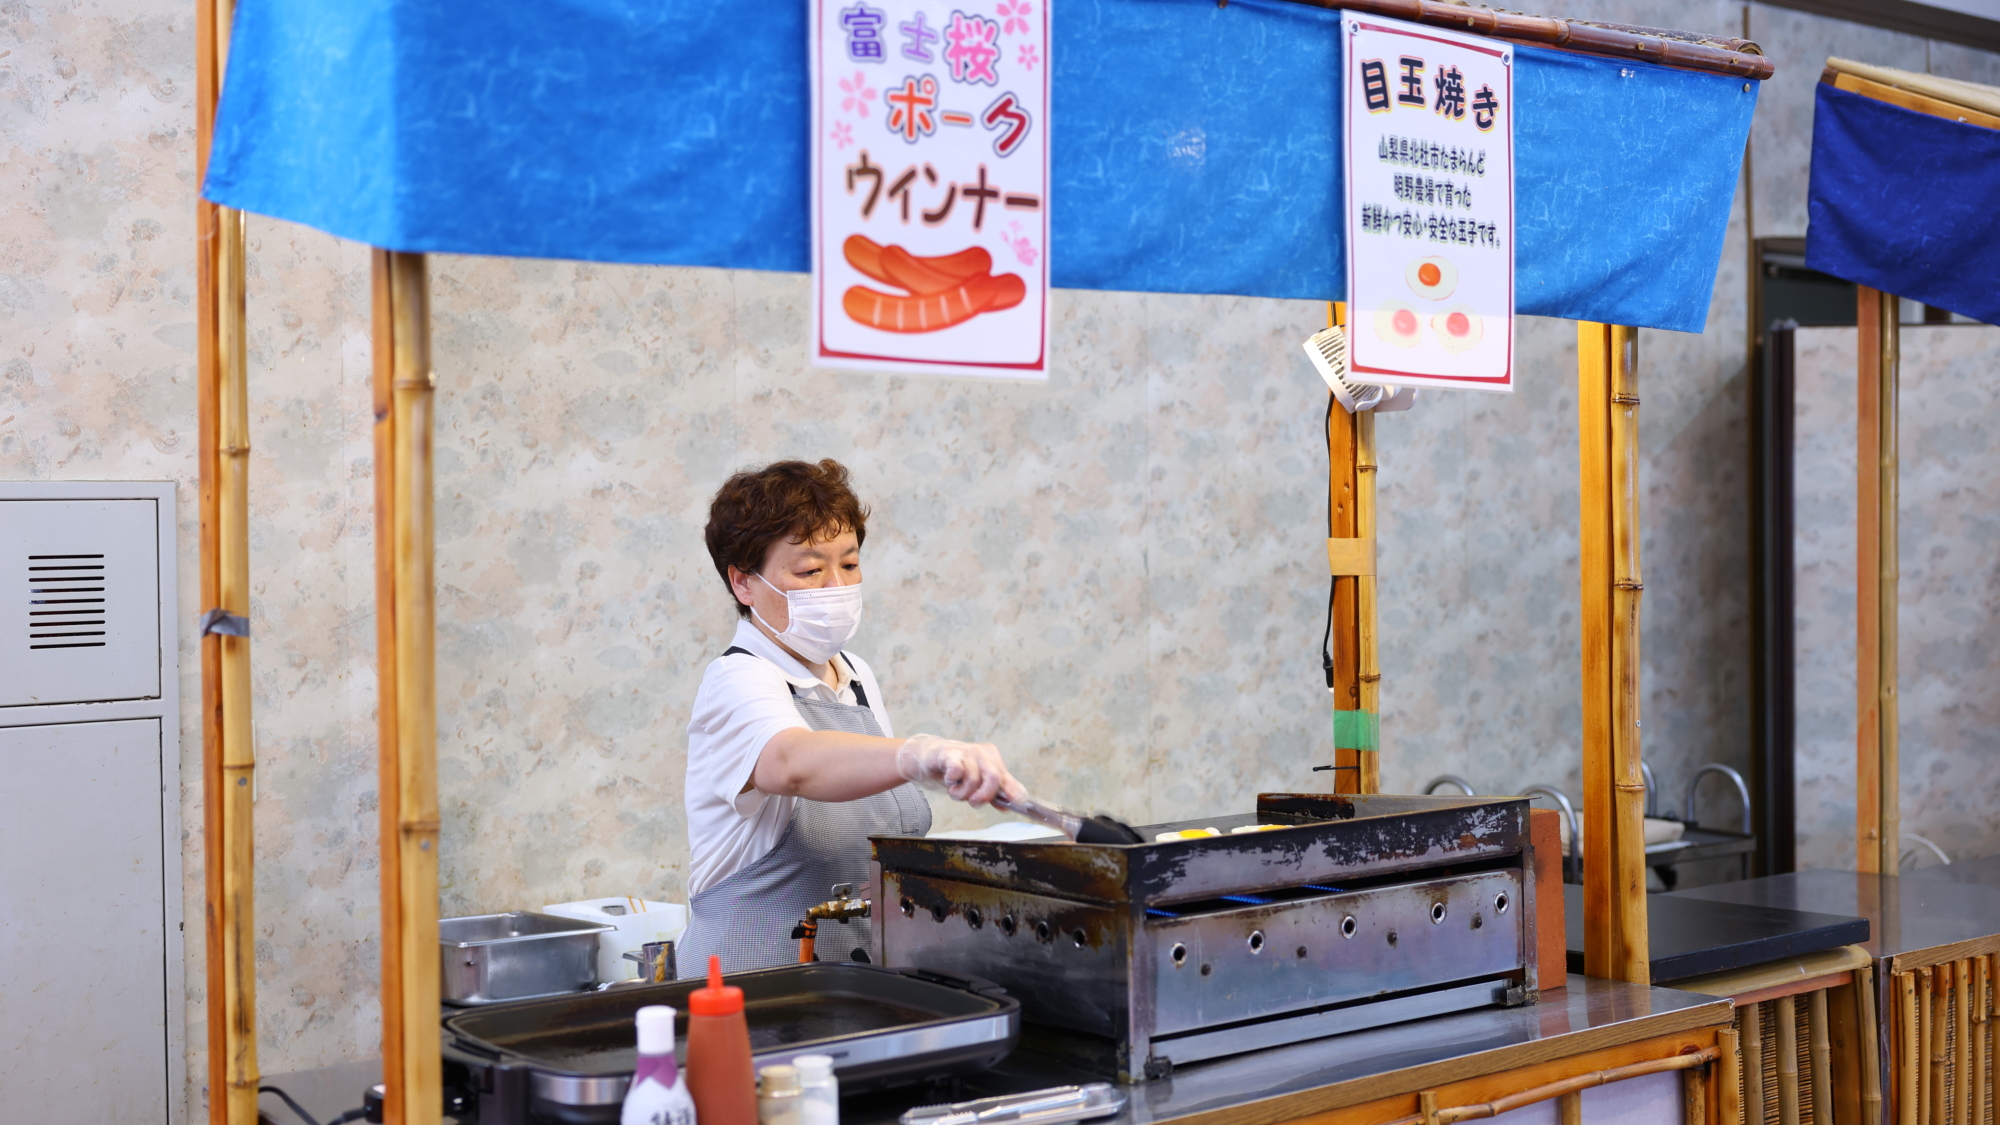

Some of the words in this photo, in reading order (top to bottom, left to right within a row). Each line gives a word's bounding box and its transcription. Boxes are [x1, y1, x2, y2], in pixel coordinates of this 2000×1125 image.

[842, 5, 998, 84] 富士桜
[888, 76, 1029, 155] ポーク
[1361, 56, 1499, 130] 目玉焼き
[846, 152, 1040, 230] ウインナー
[1379, 135, 1486, 176] 山梨県北杜市たまらんど
[1394, 173, 1471, 209] 明野農場で育った
